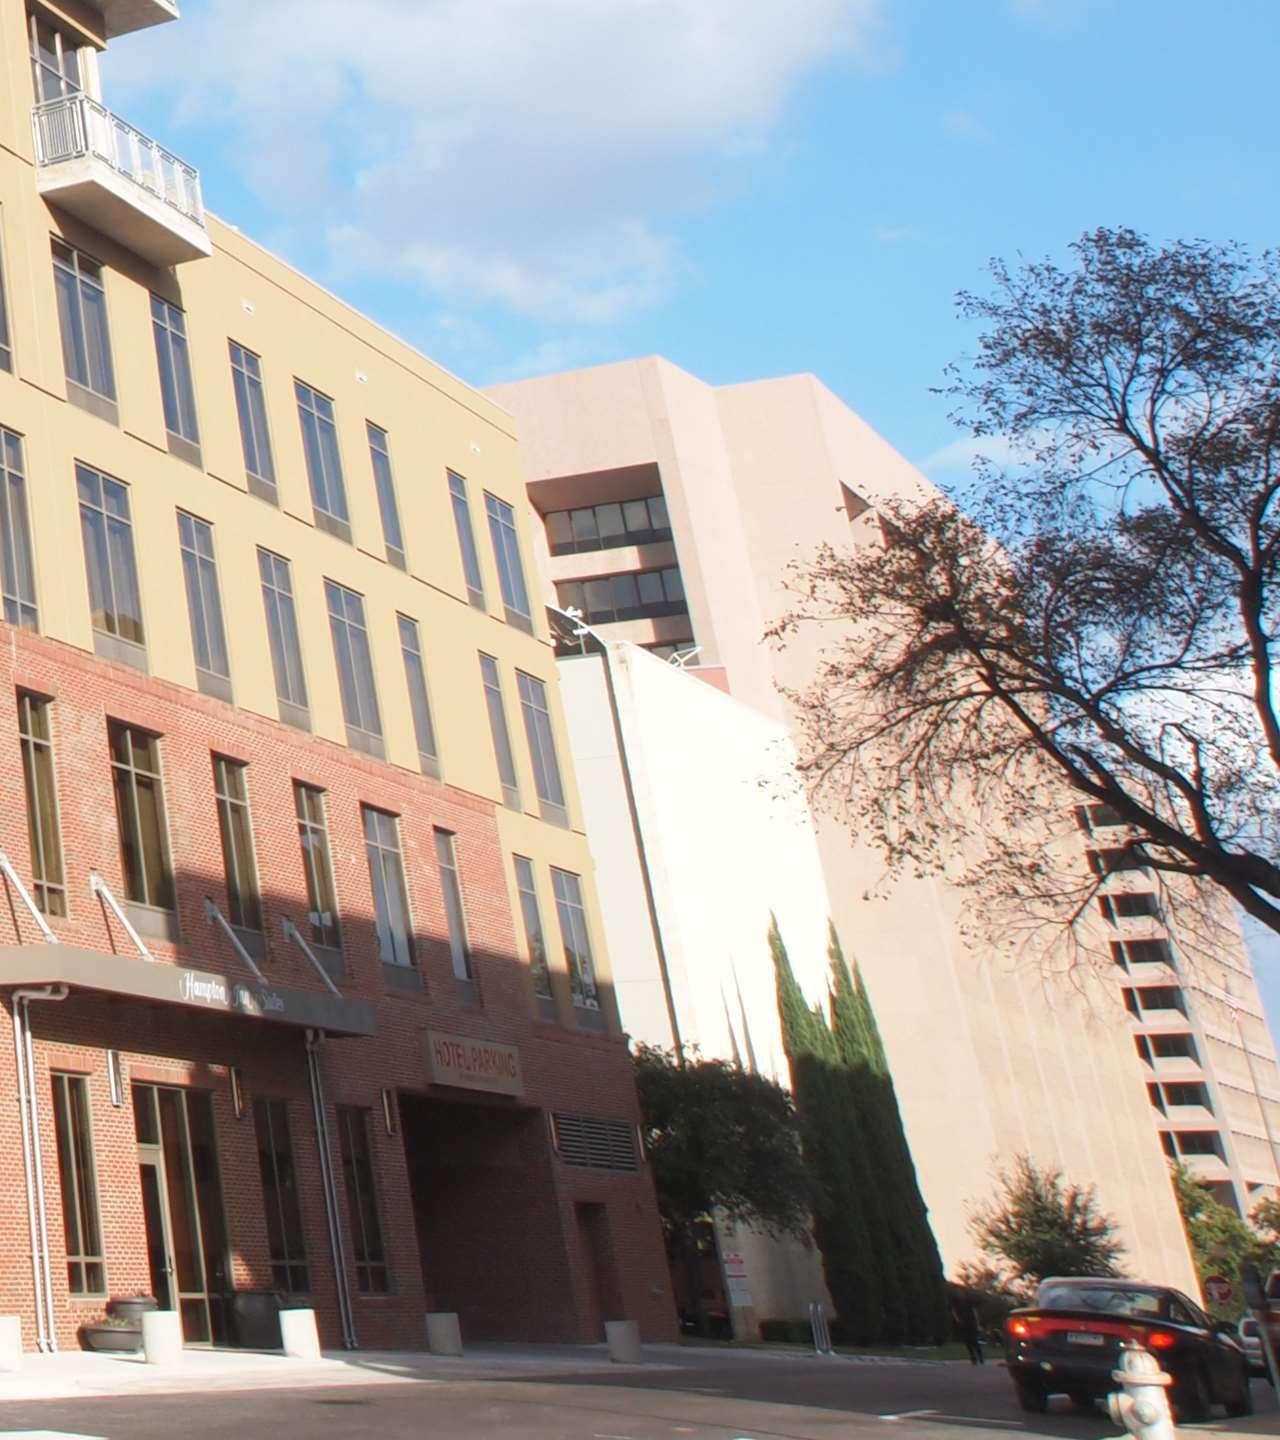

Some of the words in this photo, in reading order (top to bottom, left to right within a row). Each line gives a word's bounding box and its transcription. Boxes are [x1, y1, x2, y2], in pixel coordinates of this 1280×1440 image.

[178, 972, 230, 1006] Hampton
[432, 1039, 471, 1071] HOTEL
[471, 1045, 517, 1079] PARKING
